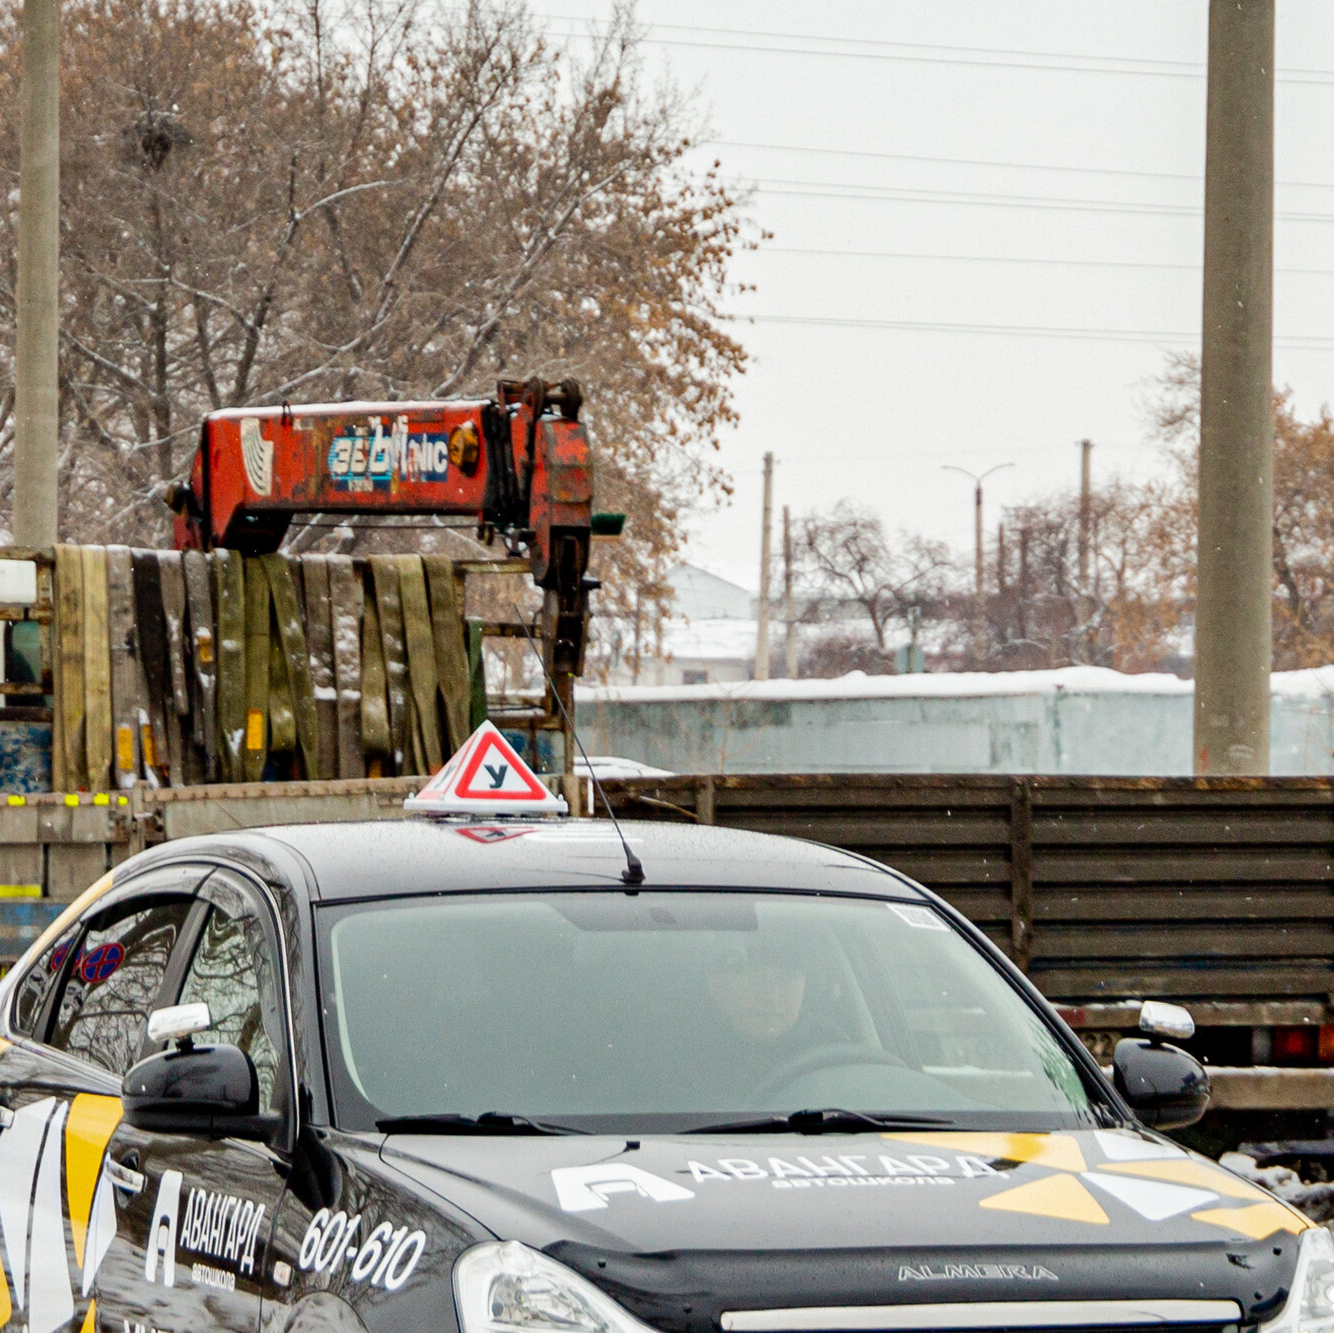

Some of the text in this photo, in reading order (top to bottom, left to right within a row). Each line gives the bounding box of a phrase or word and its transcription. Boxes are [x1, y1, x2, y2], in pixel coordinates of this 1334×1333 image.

[688, 1154, 1010, 1182] АВАНГАРД
[772, 1176, 955, 1189] автошкола
[180, 1187, 266, 1275] АВАНГАРД
[299, 1207, 427, 1290] 601-610
[191, 1263, 236, 1291] автошкола
[898, 1264, 1060, 1281] ALMERA
